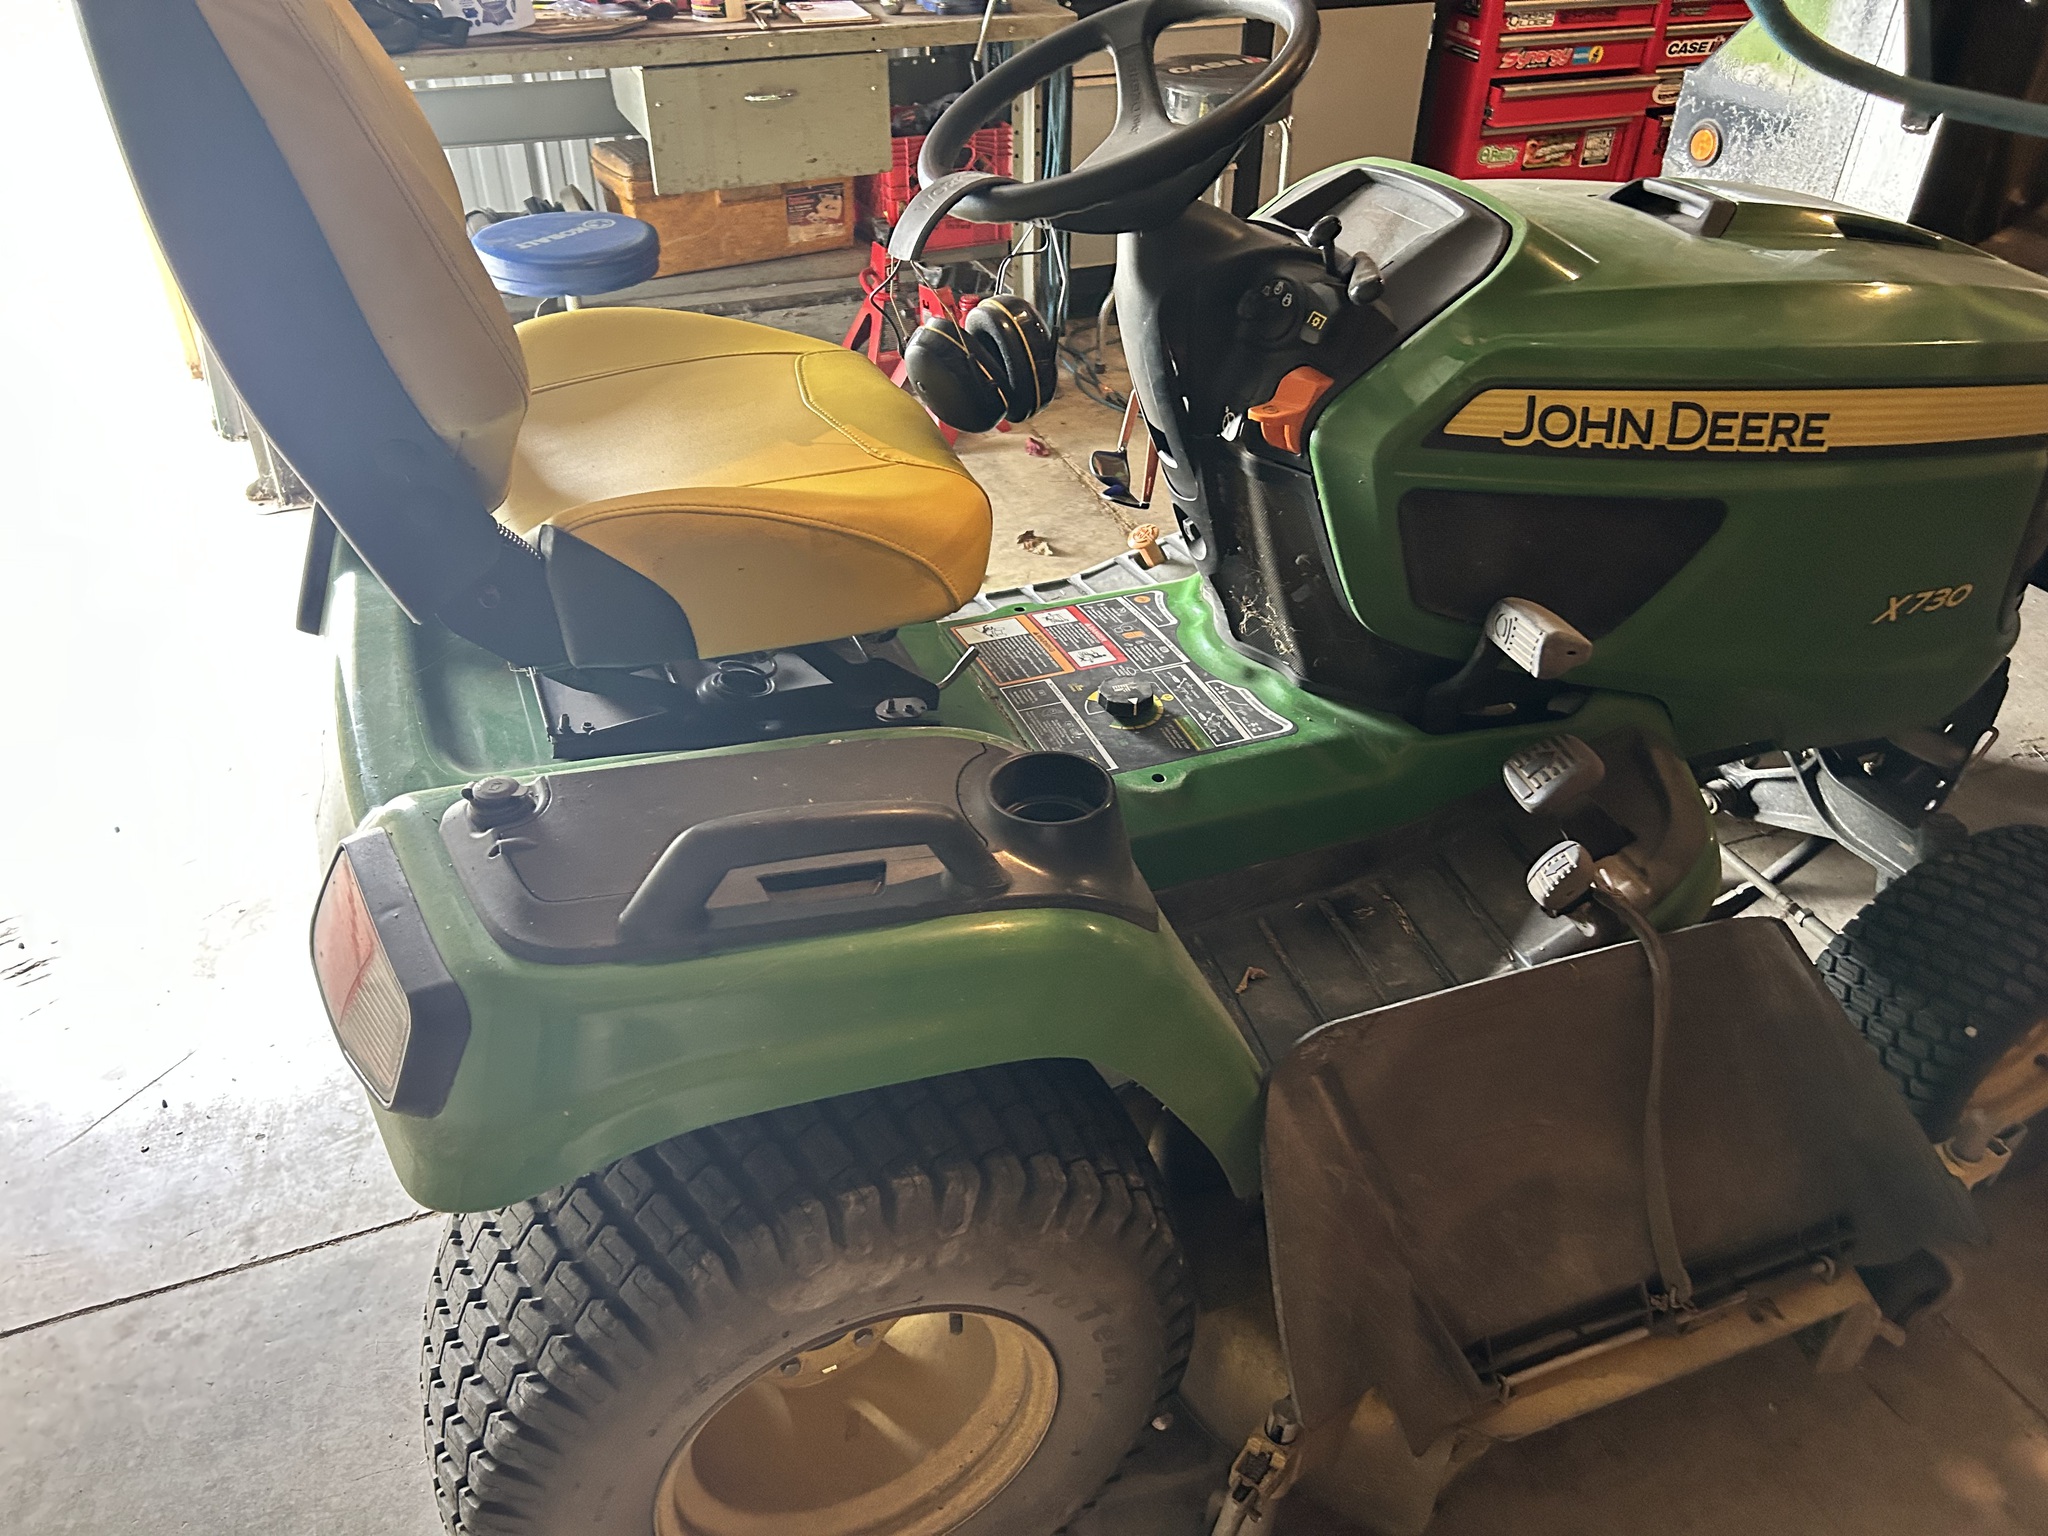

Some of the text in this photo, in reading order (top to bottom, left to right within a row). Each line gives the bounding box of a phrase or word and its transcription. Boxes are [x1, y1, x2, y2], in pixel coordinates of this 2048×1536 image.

[1667, 41, 1709, 55] CASE
[1168, 58, 1246, 75] CASE
[515, 225, 591, 250] KOBALT
[1502, 394, 1831, 448] JOHN DEERE
[1870, 583, 1974, 625] X730
[1035, 632, 1056, 653] WARNING
[1087, 623, 1108, 643] DANGER
